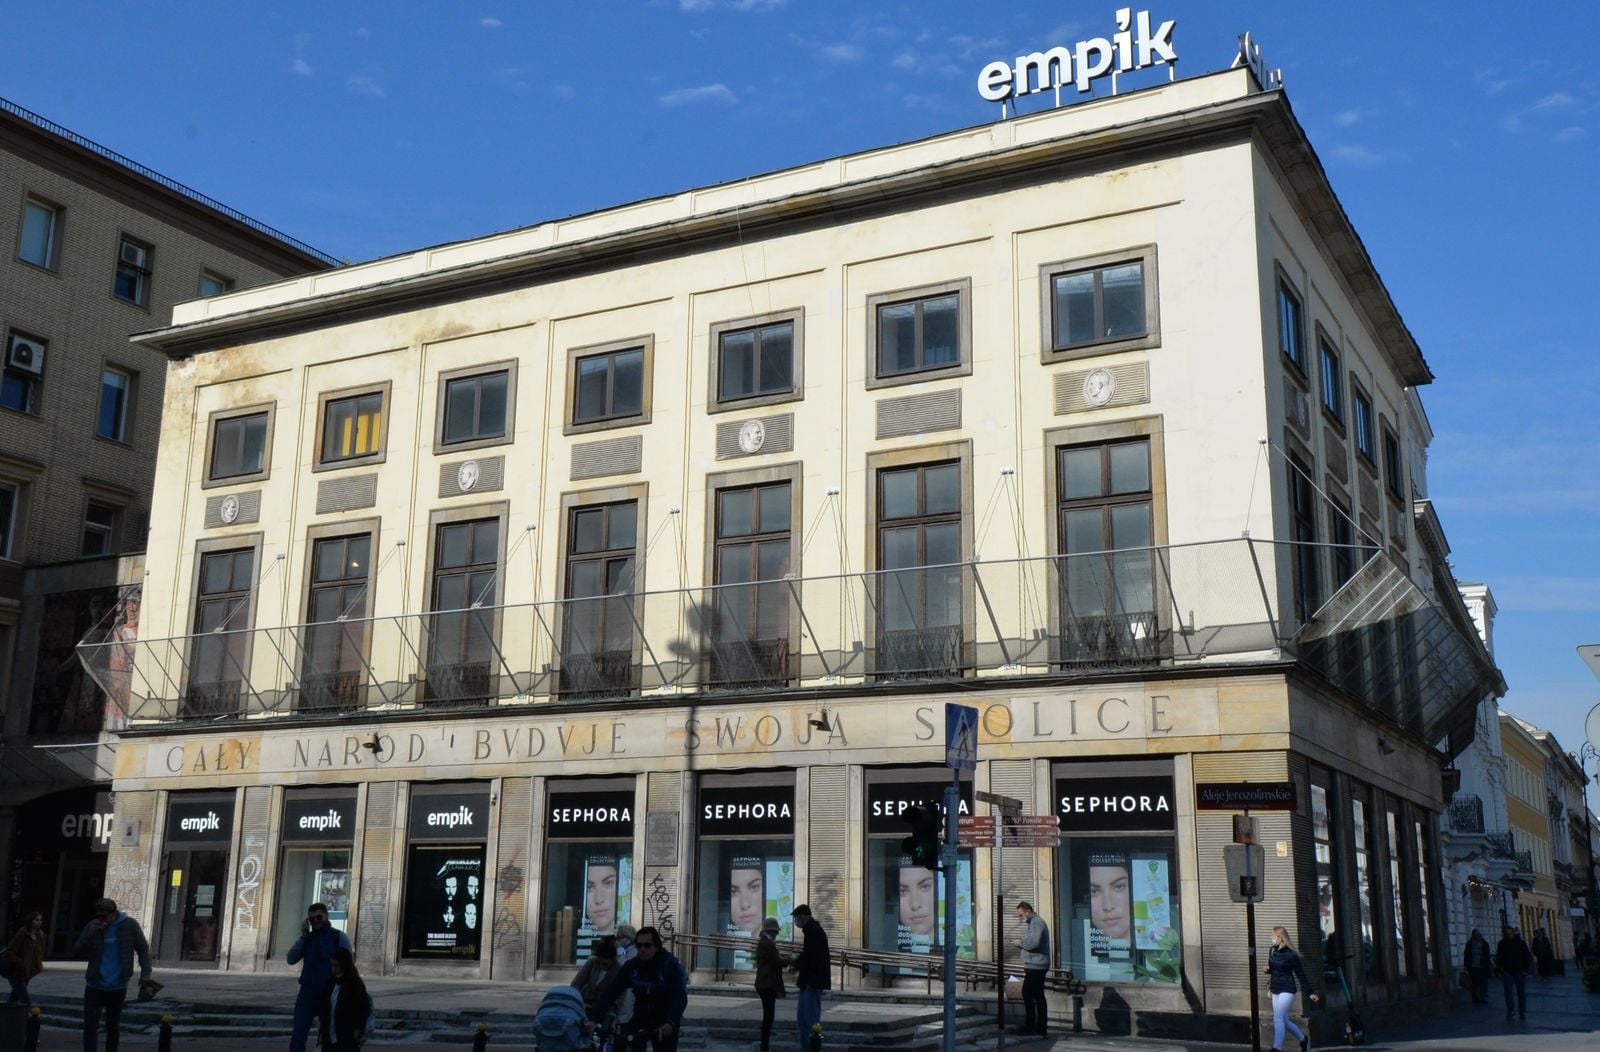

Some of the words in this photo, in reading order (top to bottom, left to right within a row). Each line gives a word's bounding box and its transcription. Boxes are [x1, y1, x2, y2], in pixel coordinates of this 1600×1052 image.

[977, 7, 1179, 101] empik
[166, 741, 253, 773] CAŁY
[1061, 795, 1169, 813] SEPHORA
[1202, 788, 1225, 803] Aleje
[1226, 787, 1291, 802] Jerozolimskie
[181, 811, 220, 832] empik
[299, 808, 342, 831] empik
[427, 805, 473, 828] empik
[552, 807, 631, 823] SEPHORA
[704, 802, 791, 820] SEPHORA
